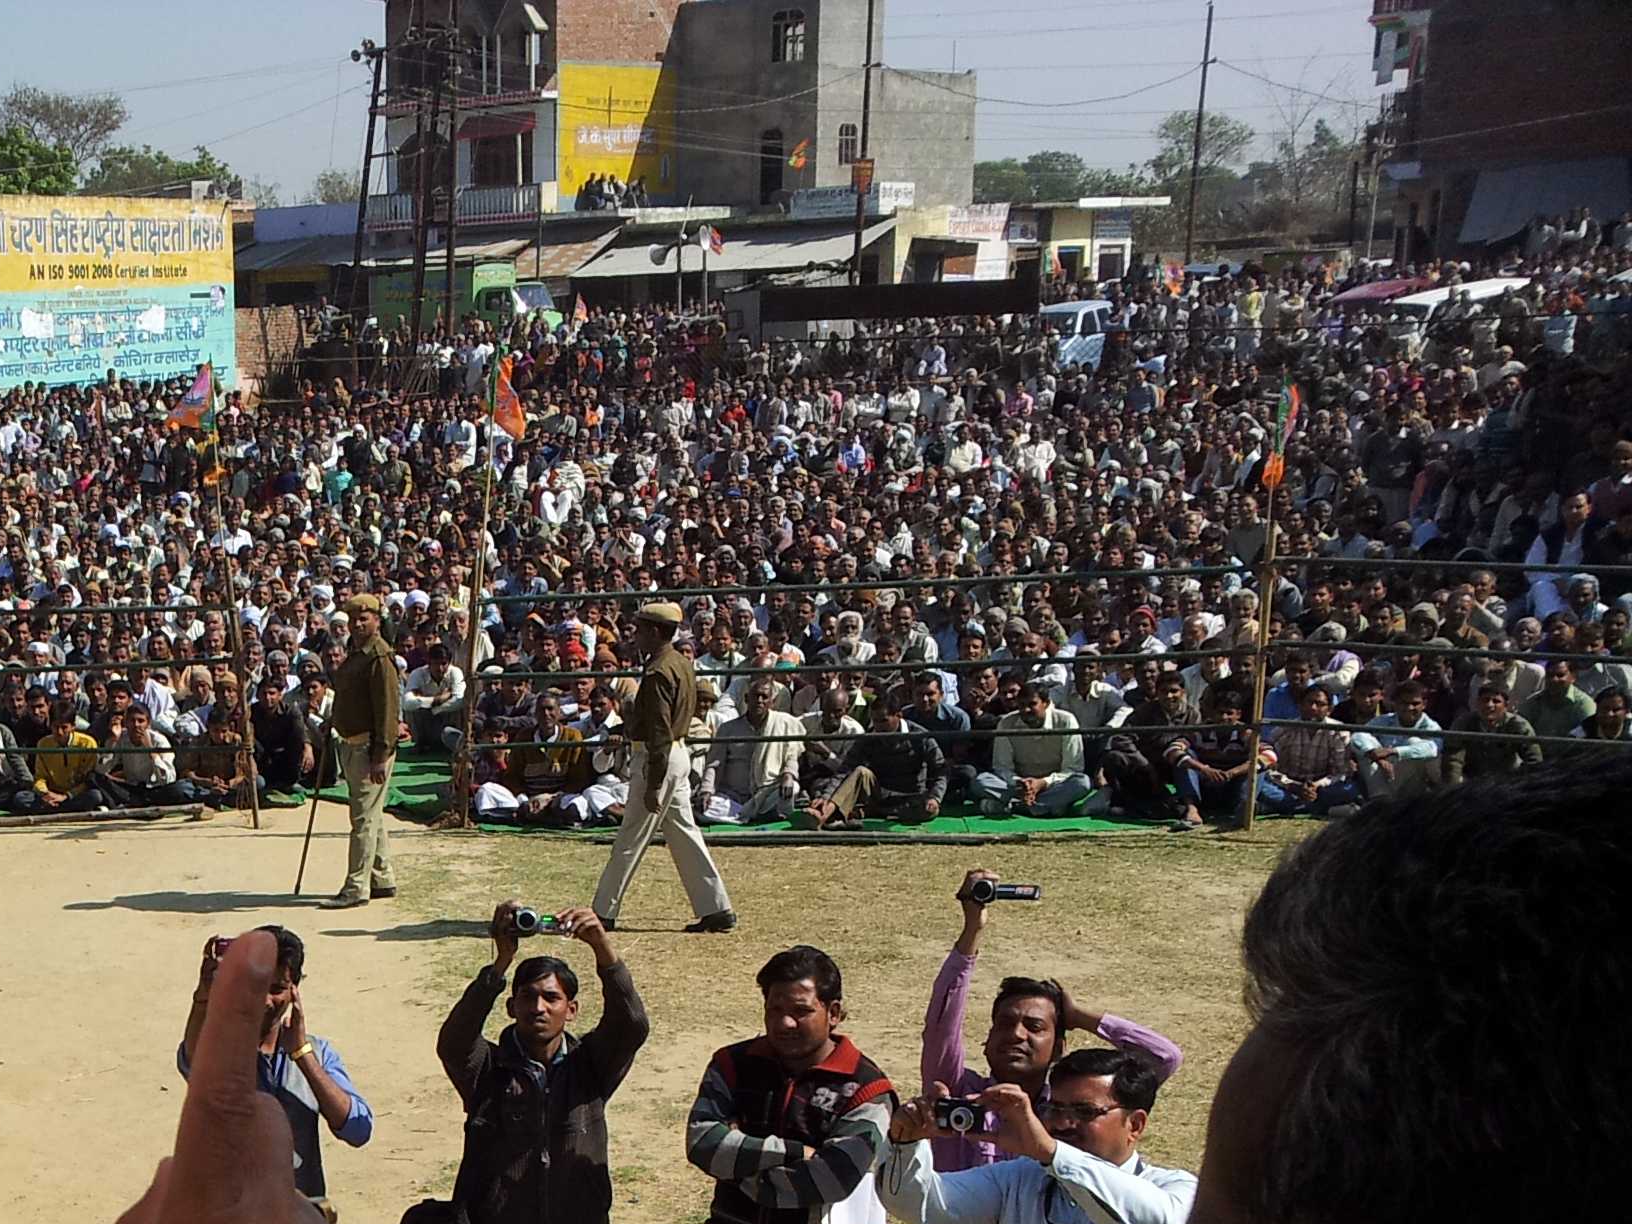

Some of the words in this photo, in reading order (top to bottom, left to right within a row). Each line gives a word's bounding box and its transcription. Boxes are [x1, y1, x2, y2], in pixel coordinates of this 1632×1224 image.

[10, 217, 48, 254] चरण
[50, 208, 79, 254] सिंह
[130, 216, 186, 257] साक्षरता
[29, 264, 45, 281] AN
[48, 263, 65, 280] ISO
[68, 262, 90, 280] 9001
[115, 263, 150, 279] Certified
[152, 263, 188, 279] Institute
